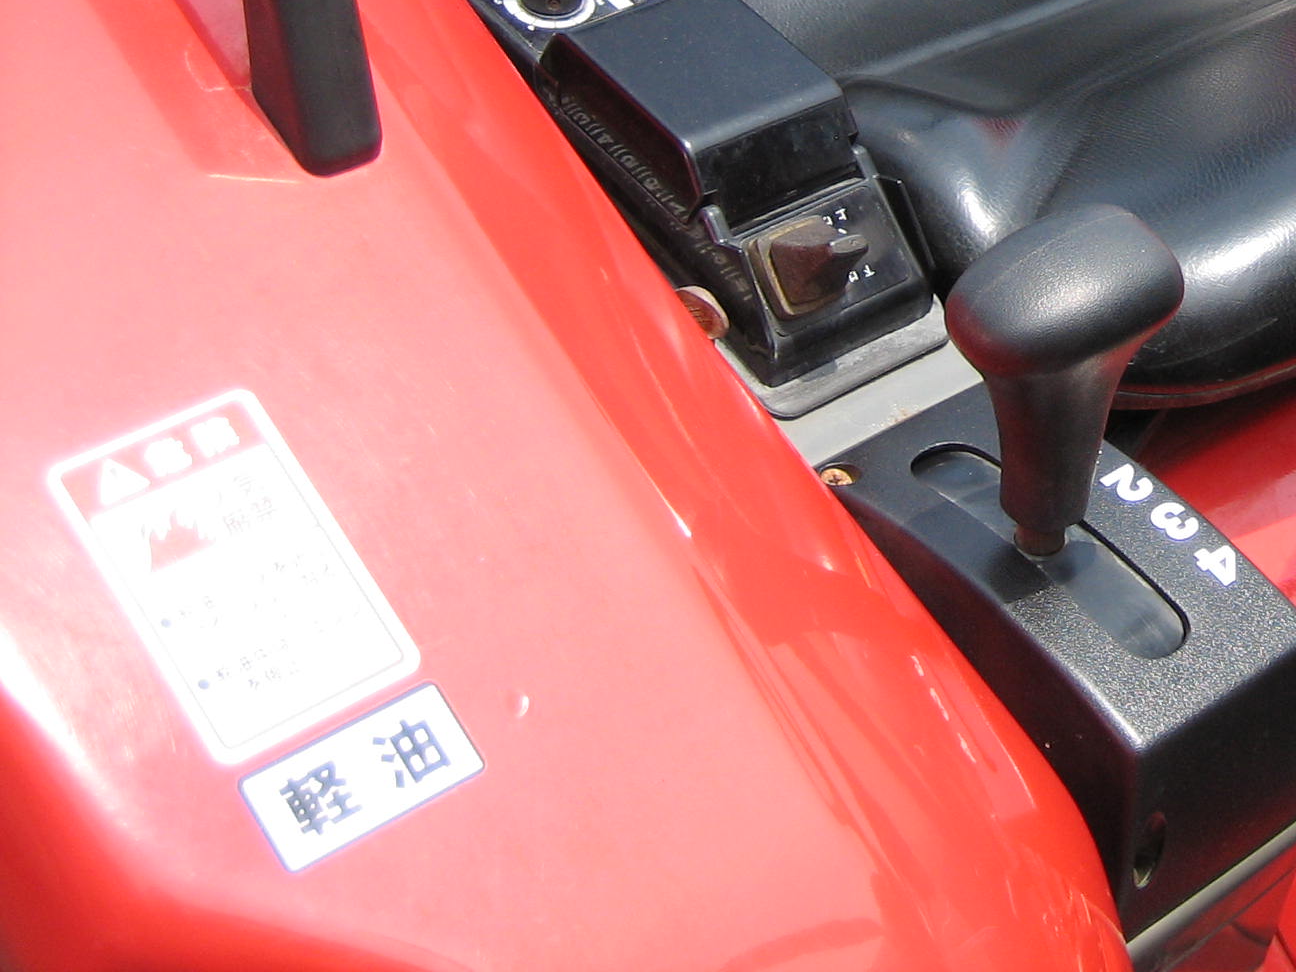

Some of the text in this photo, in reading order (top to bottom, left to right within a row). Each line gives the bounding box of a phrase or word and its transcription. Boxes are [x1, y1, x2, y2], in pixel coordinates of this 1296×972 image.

[1099, 463, 1153, 502] 2
[1150, 502, 1199, 541] 3
[1193, 545, 1236, 587] 4
[279, 720, 451, 835] 軽油
